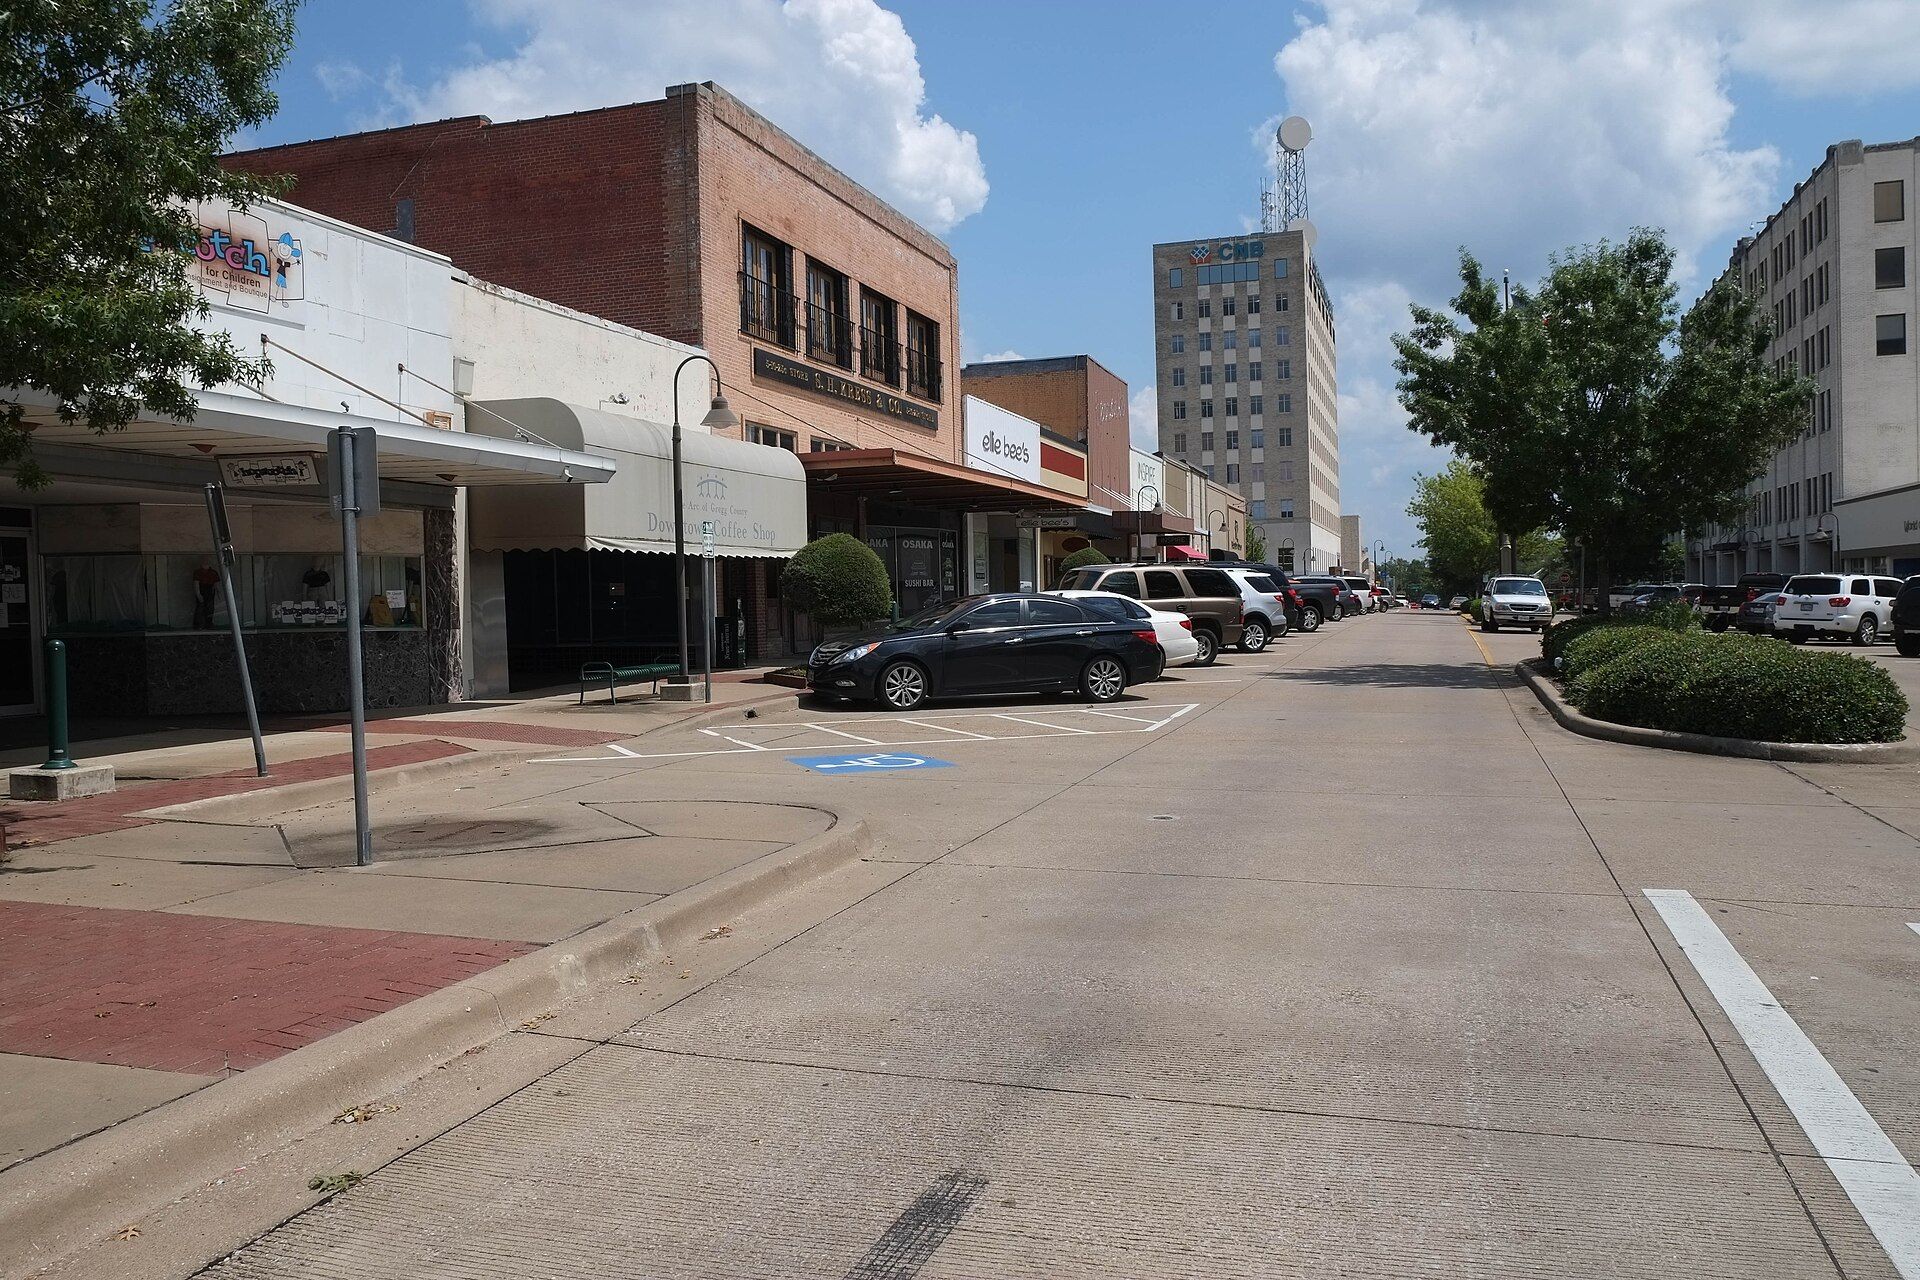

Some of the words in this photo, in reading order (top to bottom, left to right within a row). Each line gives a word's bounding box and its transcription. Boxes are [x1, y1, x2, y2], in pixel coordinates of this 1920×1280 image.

[1219, 241, 1265, 260] CNB
[186, 274, 223, 288] nsignment
[224, 281, 238, 292] and
[239, 282, 268, 299] Boutique
[205, 266, 219, 278] for
[222, 270, 261, 288] Children
[790, 367, 809, 382] STORE
[814, 372, 824, 389] S.
[827, 377, 838, 395] H.
[840, 380, 872, 405] KRESS
[876, 393, 884, 409] &
[888, 398, 903, 415] CO.
[1003, 435, 1030, 464] bee's
[689, 501, 700, 512] Arc
[711, 503, 728, 517] Gregg
[647, 512, 703, 536] Dowtow
[714, 520, 748, 541] Coffee
[752, 522, 776, 547] Shop
[869, 538, 888, 548] AKA
[902, 540, 933, 549] OSAKA
[905, 579, 921, 588] SUSHI
[922, 579, 935, 587] BAR
